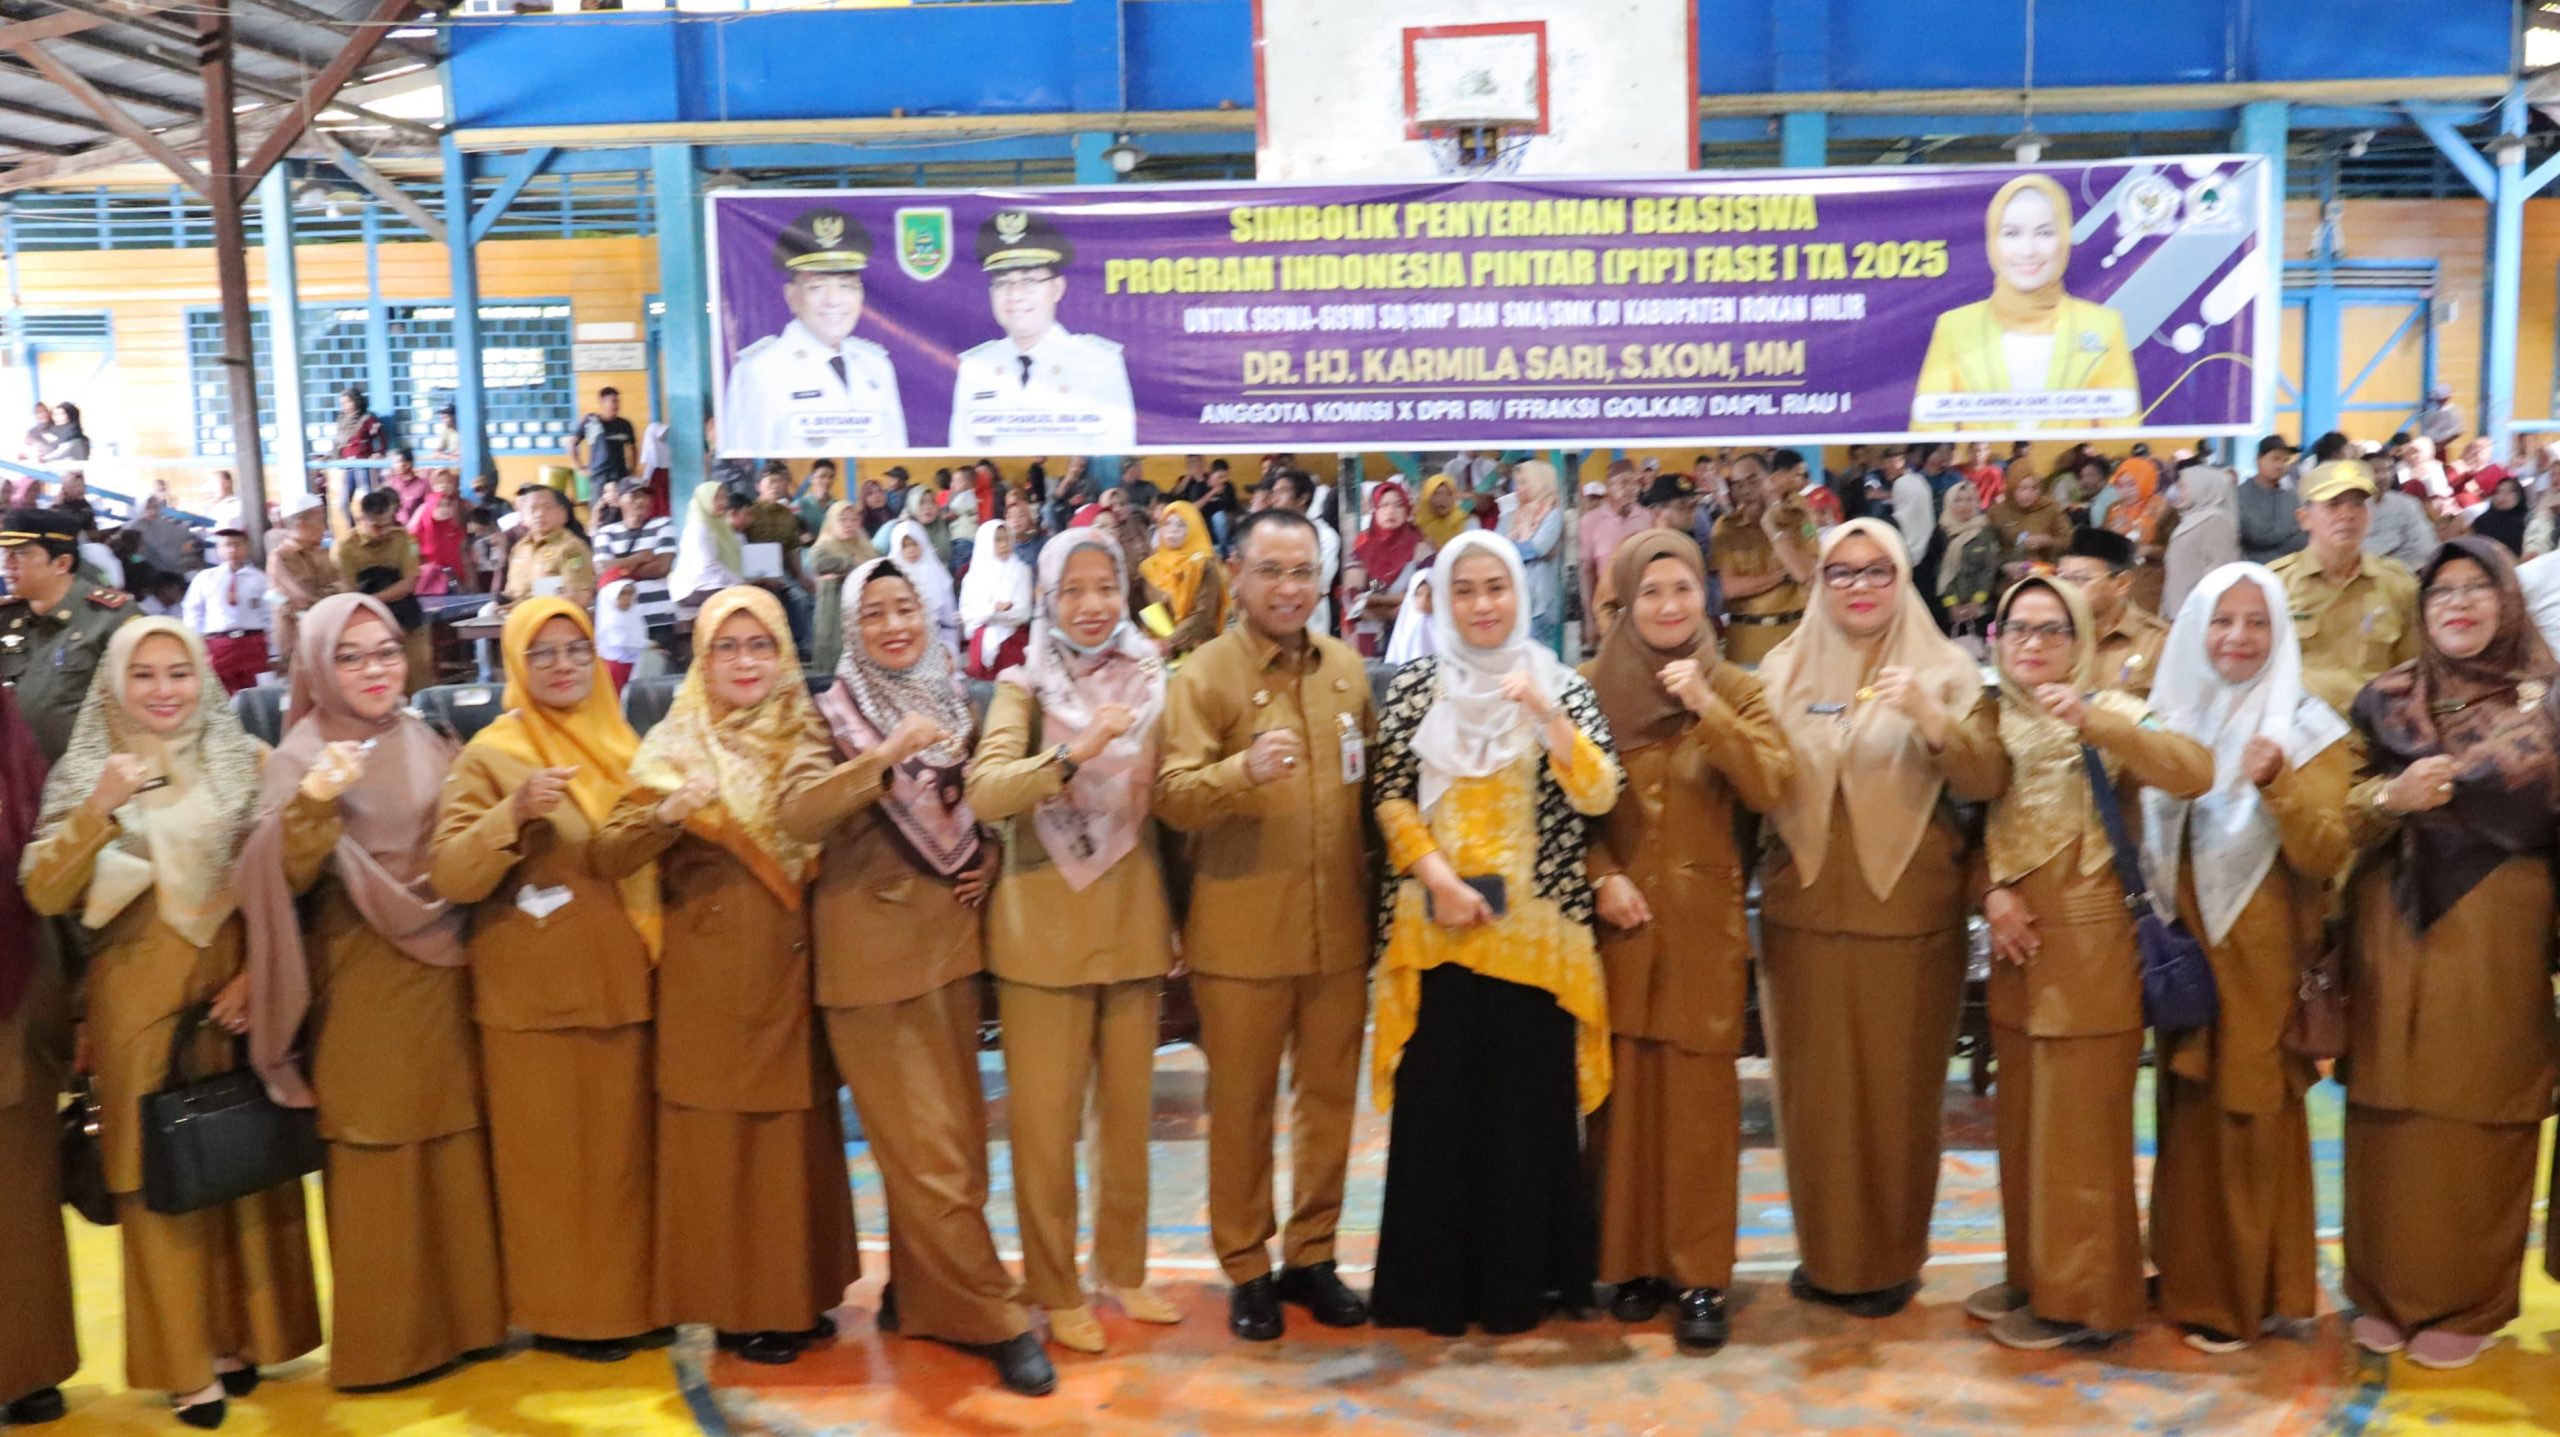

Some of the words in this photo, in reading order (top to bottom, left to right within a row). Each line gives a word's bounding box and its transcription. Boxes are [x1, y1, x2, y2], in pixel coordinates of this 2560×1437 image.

[1230, 203, 1401, 243] SIMBOLIK
[1405, 199, 1627, 239] PENYERAHAN
[1632, 195, 1819, 234] BEASISWA
[1104, 256, 1275, 294] PROGRAM
[1280, 252, 1467, 291] INDONESIA
[1471, 249, 1596, 288] PINTAR
[1602, 247, 1688, 284] (PIP)
[1694, 244, 1778, 283] FASE
[1783, 244, 1797, 281] I
[1802, 243, 1848, 280] TA
[1852, 240, 1949, 279] 2025
[1183, 306, 1250, 333] UNTUK
[1250, 303, 1376, 332] SISWA-SISWI
[1457, 302, 1499, 329] DAN
[1597, 299, 1620, 326] DI
[1623, 297, 1737, 325] KABUPATEN
[1739, 295, 1808, 323] ROKAN
[1810, 293, 1866, 321] HILIR
[1242, 351, 1300, 385] DR.
[1305, 349, 1358, 384] HJ.
[1362, 346, 1520, 383] KARMILA
[1525, 344, 1616, 384] SARI,
[1620, 342, 1739, 382] S.KOM,
[1745, 339, 1806, 376] MM
[1199, 401, 1310, 424] ANGGOTA
[1312, 401, 1395, 422] KOMISI
[1396, 400, 1415, 421] X
[1417, 399, 1467, 421] DPR
[1504, 397, 1600, 420] FFRAKSI
[1709, 394, 1779, 416] DAPIL
[1780, 393, 1839, 414] RIAU
